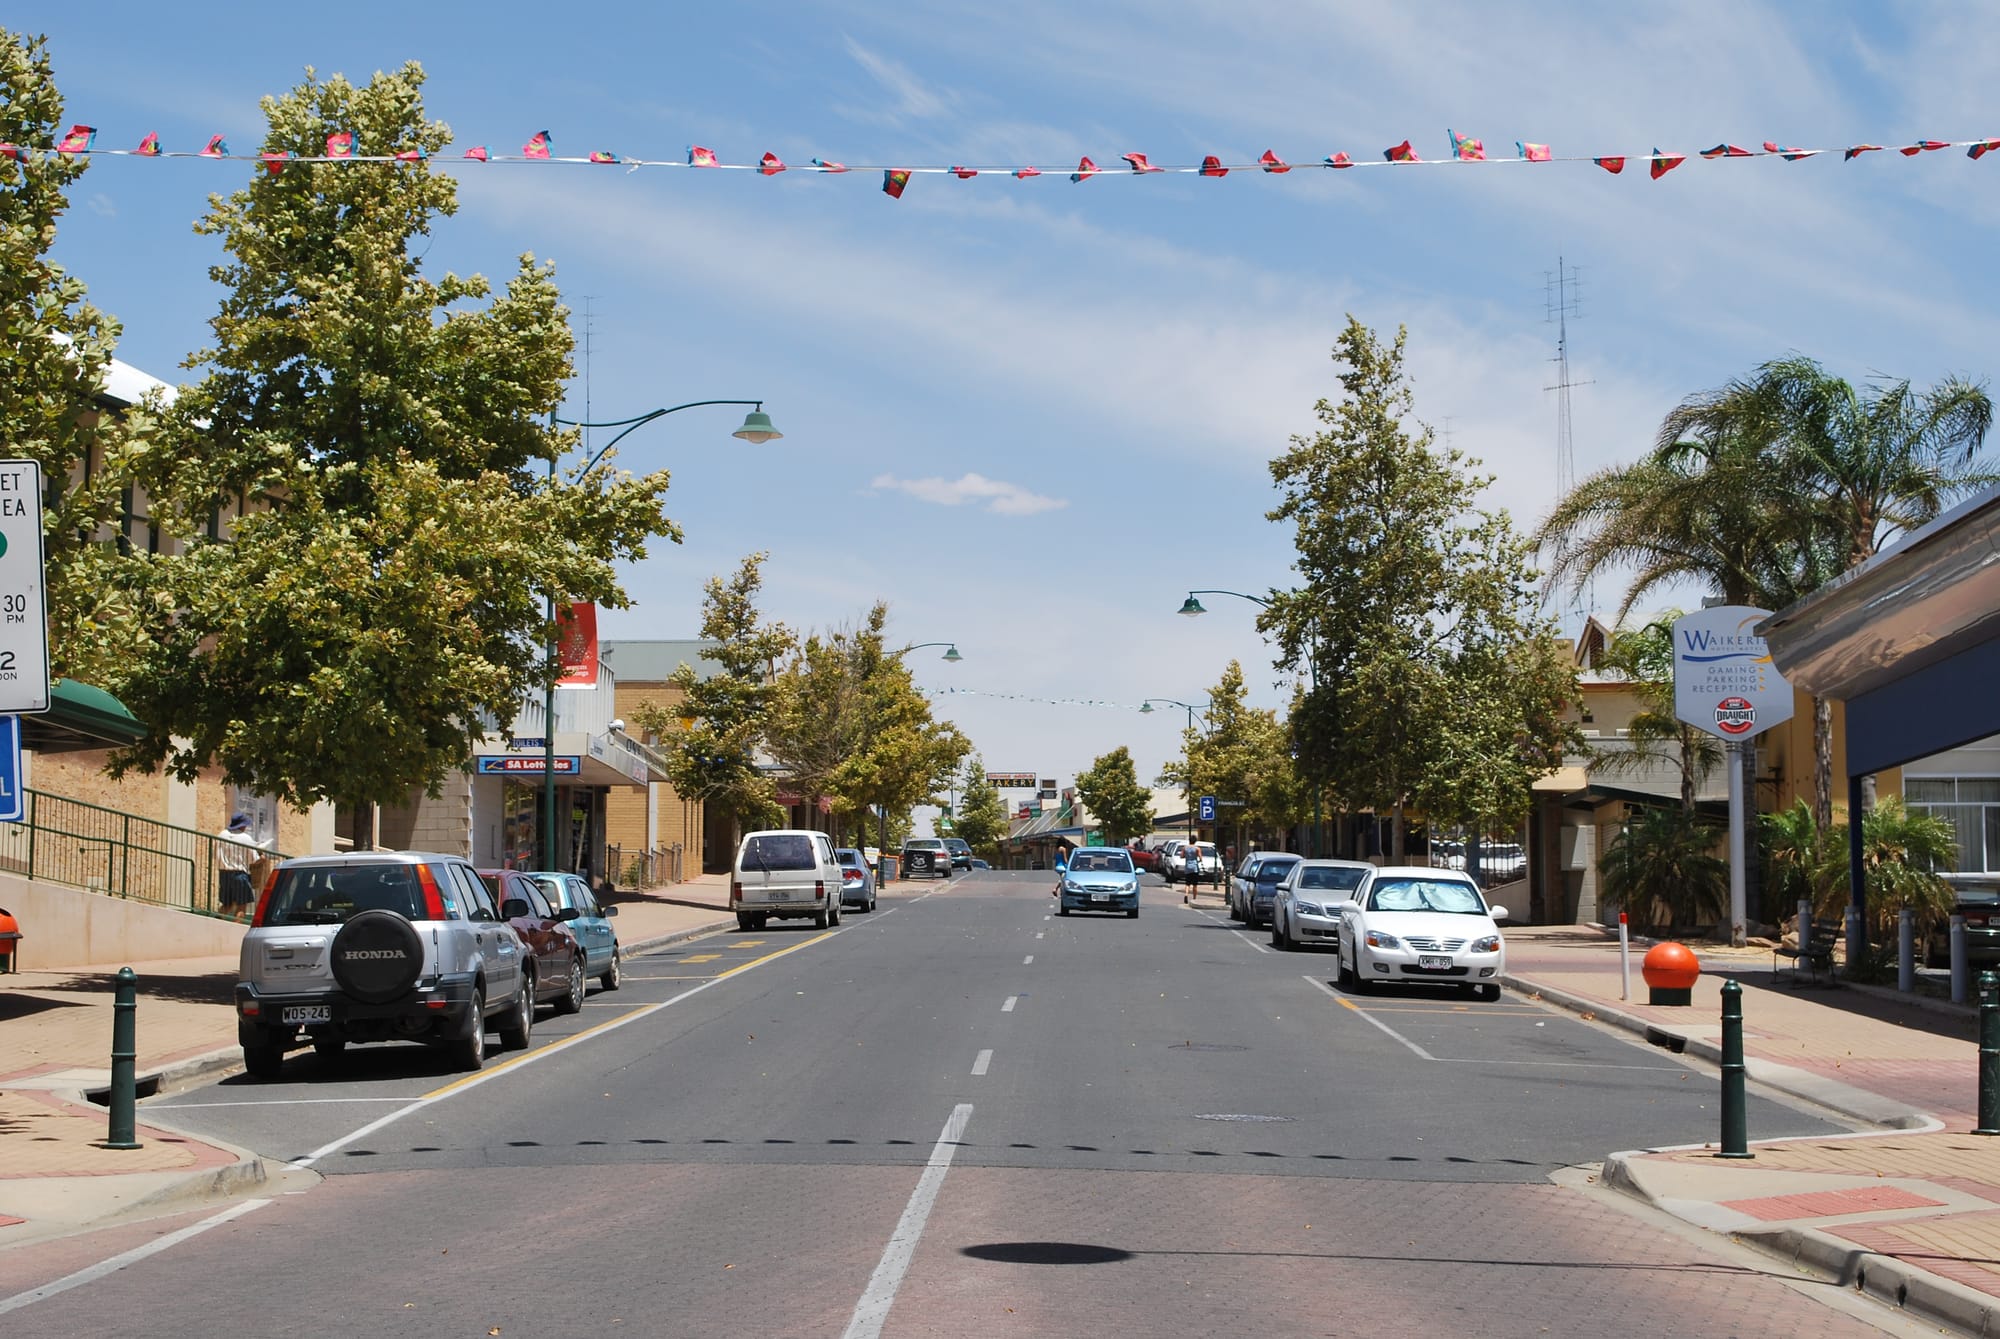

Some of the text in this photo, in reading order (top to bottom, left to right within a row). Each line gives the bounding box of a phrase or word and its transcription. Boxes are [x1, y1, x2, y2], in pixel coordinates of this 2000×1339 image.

[7, 614, 25, 624] PM
[1708, 666, 1757, 674] GAMING
[1706, 675, 1757, 683] PARKING
[1692, 684, 1758, 693] RECEPTION
[1716, 710, 1754, 721] DRAUGHT
[507, 760, 569, 769] SA Lotties
[1202, 806, 1212, 818] P
[344, 949, 407, 960] HONDA
